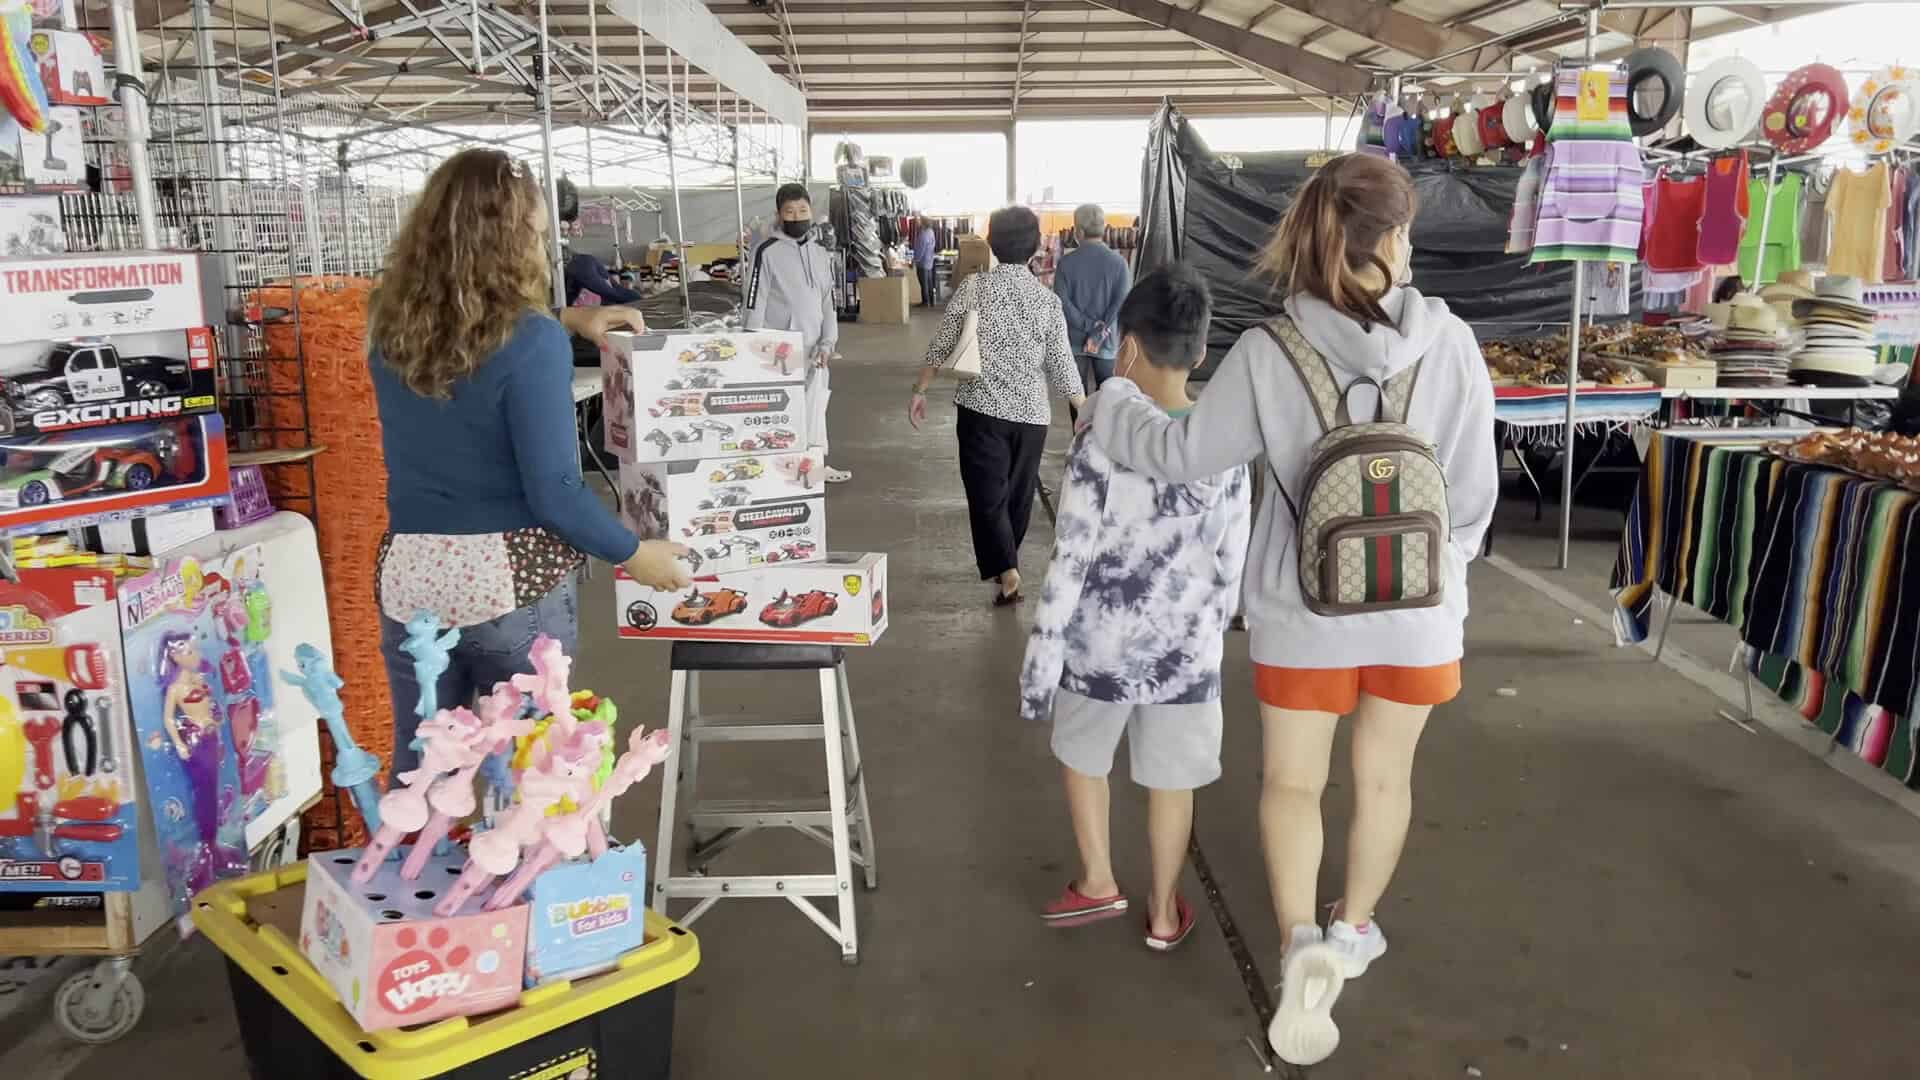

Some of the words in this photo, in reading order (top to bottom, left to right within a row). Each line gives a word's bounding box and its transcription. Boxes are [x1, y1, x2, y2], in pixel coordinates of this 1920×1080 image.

[4, 263, 183, 293] TRANSFORMATION
[33, 396, 183, 428] EXCITING
[392, 960, 431, 981] TOYS
[384, 972, 470, 1012] Happy
